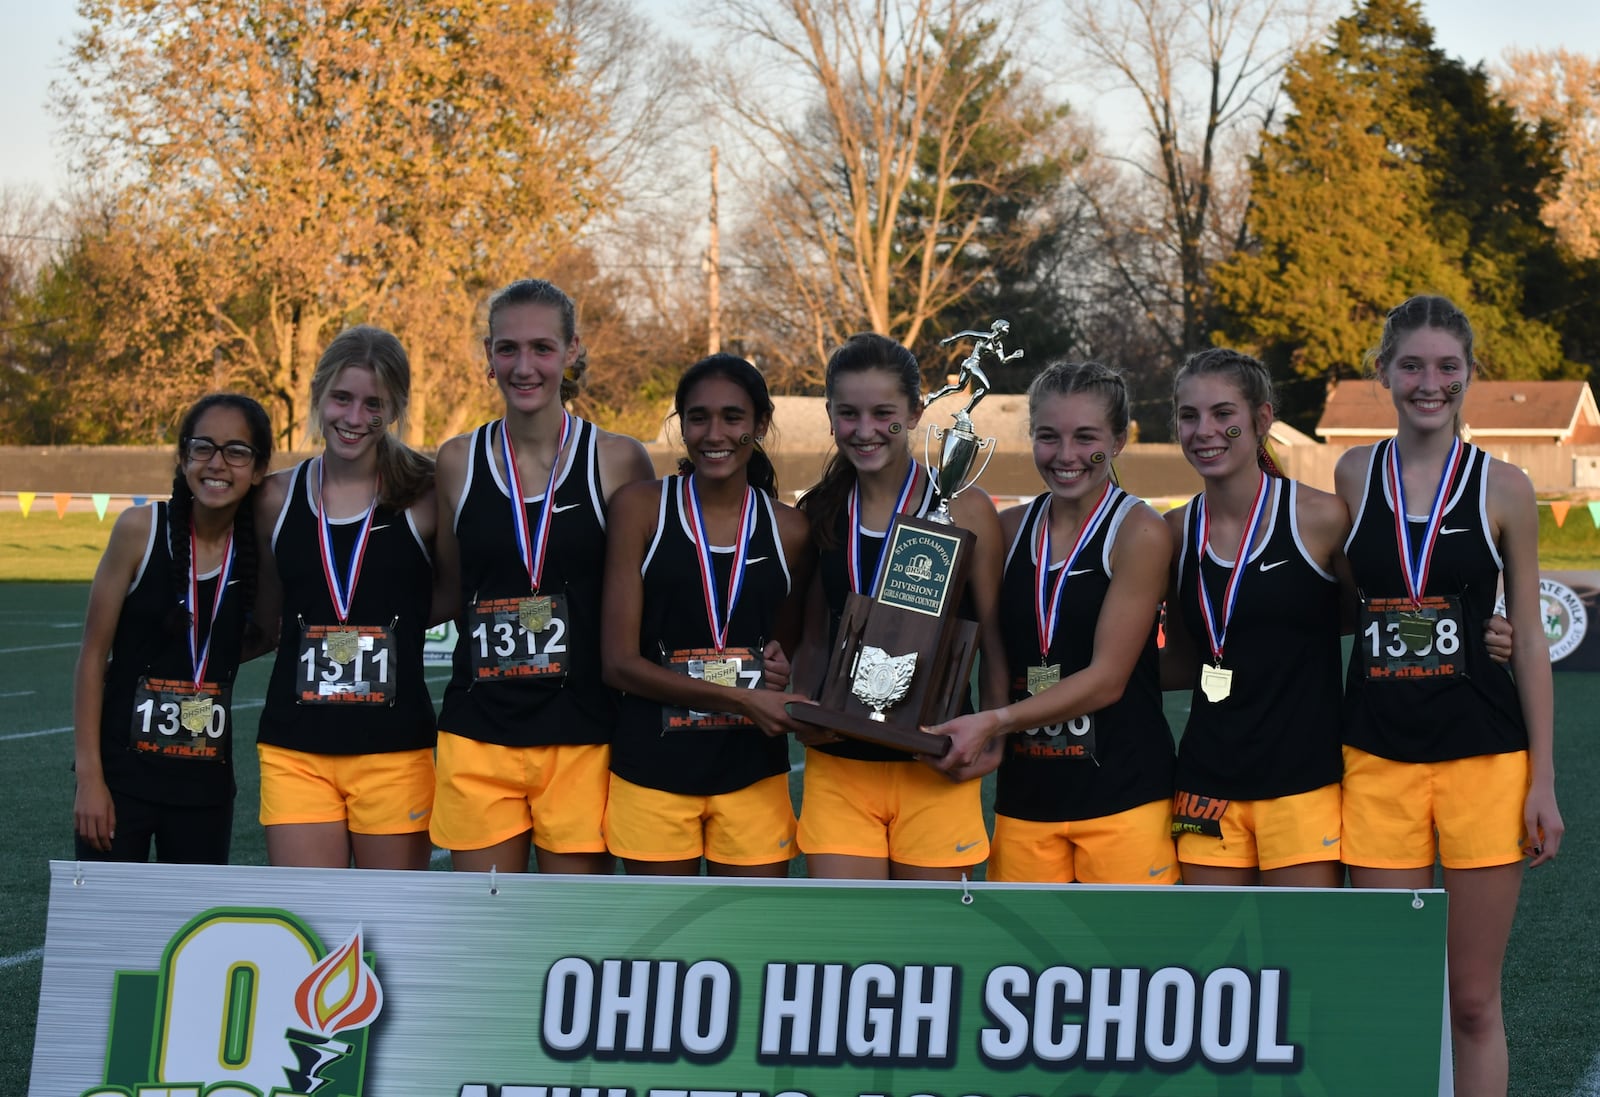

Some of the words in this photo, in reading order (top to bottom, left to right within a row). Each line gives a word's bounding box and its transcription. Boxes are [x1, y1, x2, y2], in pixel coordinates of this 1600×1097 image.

[895, 537, 918, 556] STATE
[919, 537, 950, 566] CHAMPION
[891, 580, 933, 596] DIVISION
[934, 589, 939, 598] I
[893, 563, 904, 573] 20
[934, 573, 945, 583] 20
[884, 588, 899, 599] GIRLS
[898, 591, 915, 603] CROSS
[914, 596, 940, 609] COUNTRY
[1563, 593, 1584, 625] MILK
[472, 617, 566, 658] 1312
[300, 647, 389, 683] 1311
[136, 699, 226, 739] 130
[543, 957, 731, 1055] OHIO
[760, 963, 953, 1060] HIGH
[981, 966, 1296, 1065] SCHOOL
